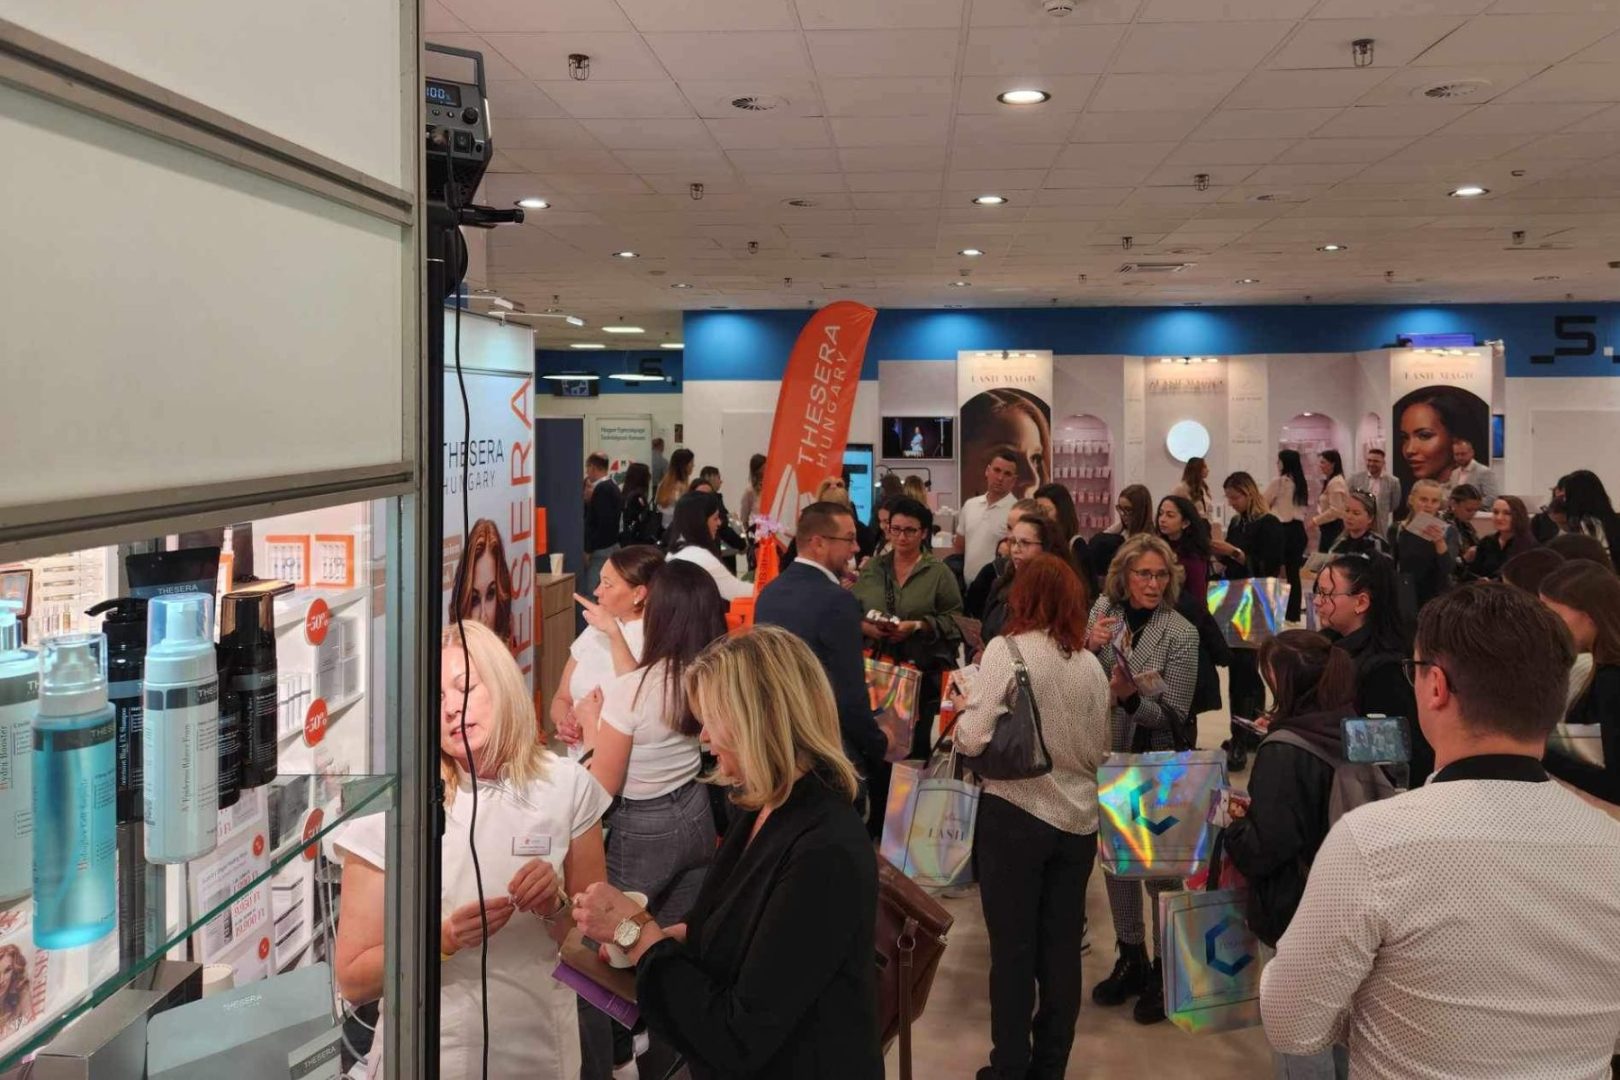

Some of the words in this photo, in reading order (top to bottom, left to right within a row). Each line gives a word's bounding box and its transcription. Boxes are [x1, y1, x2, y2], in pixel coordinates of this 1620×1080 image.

[797, 325, 840, 464] THESERA
[816, 351, 848, 468] HUNGARY
[158, 584, 199, 595] THESERA
[510, 376, 532, 675] ESERA
